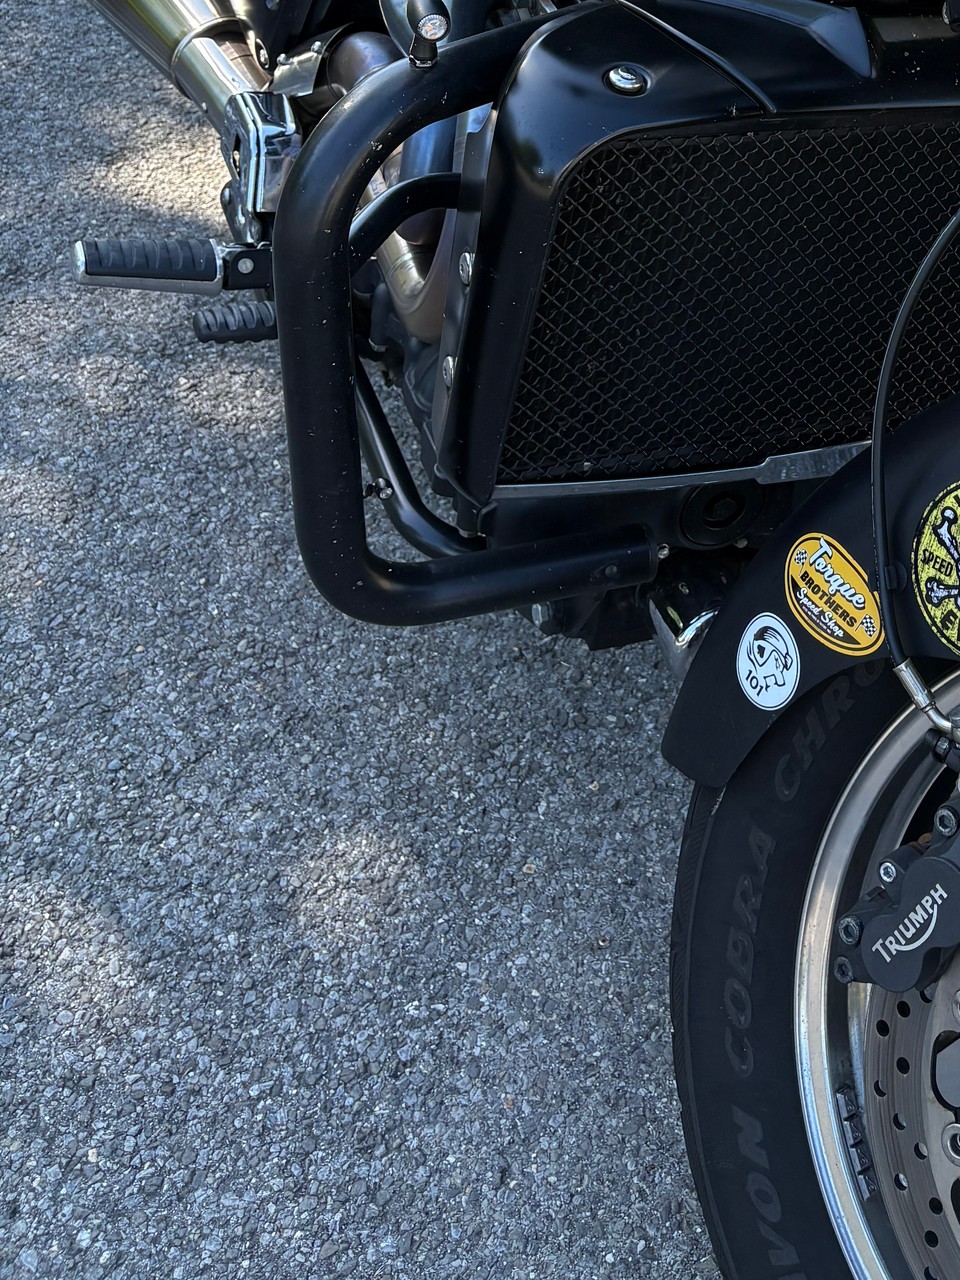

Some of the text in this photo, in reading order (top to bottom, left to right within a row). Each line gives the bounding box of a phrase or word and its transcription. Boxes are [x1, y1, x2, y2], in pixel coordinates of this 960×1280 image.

[809, 536, 866, 610] Torque
[921, 549, 954, 577] SPEED
[797, 587, 823, 616] Speed
[821, 611, 844, 637] Shop
[800, 570, 857, 627] BROTHERS
[745, 669, 764, 697] 101
[723, 825, 777, 1078] COBRA
[872, 883, 948, 963] TRIUMPH
[730, 1103, 808, 1280] VON
